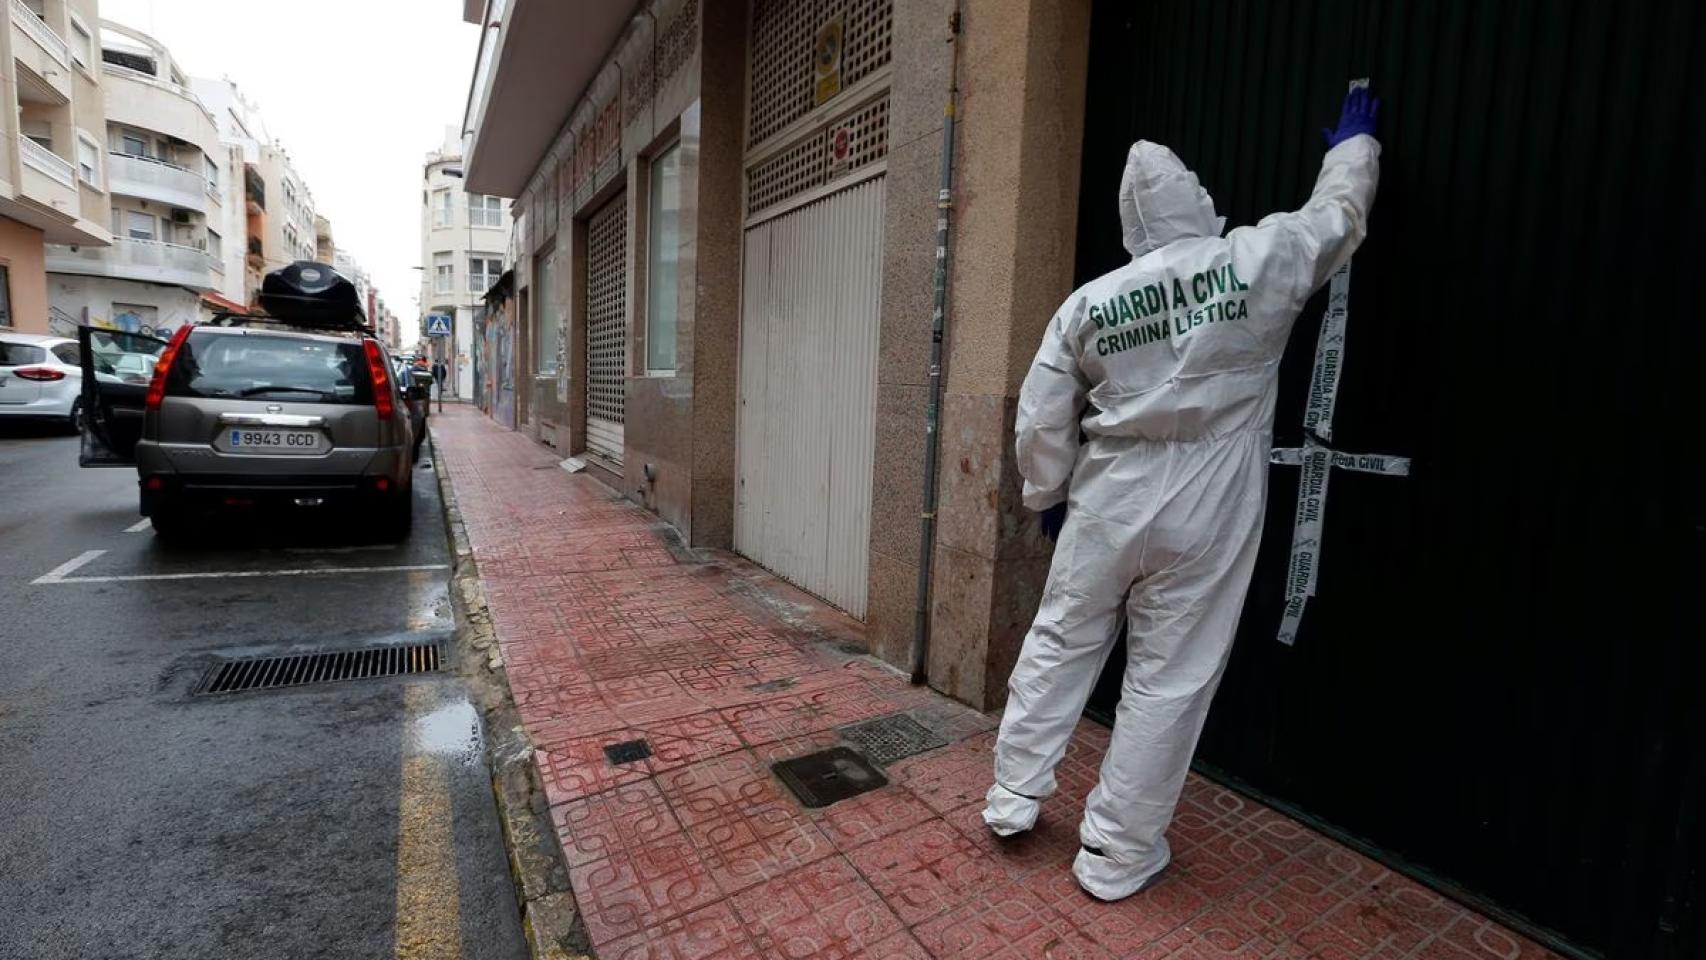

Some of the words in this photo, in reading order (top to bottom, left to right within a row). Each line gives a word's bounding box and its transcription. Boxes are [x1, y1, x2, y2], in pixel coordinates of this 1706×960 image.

[1089, 277, 1188, 330] GUARDIA
[1193, 262, 1249, 304] CIVIL
[1096, 299, 1248, 356] CRIMINALÍSTICA
[1323, 350, 1338, 394] GUARDIA
[243, 432, 281, 446] 9943
[286, 433, 314, 446] GCD
[1309, 451, 1326, 496] GUARDIA
[1358, 457, 1386, 471] CIVIL
[1305, 498, 1320, 523] CIVIL
[1295, 552, 1313, 595] GUARDIA
[1287, 595, 1303, 618] CIVIL
